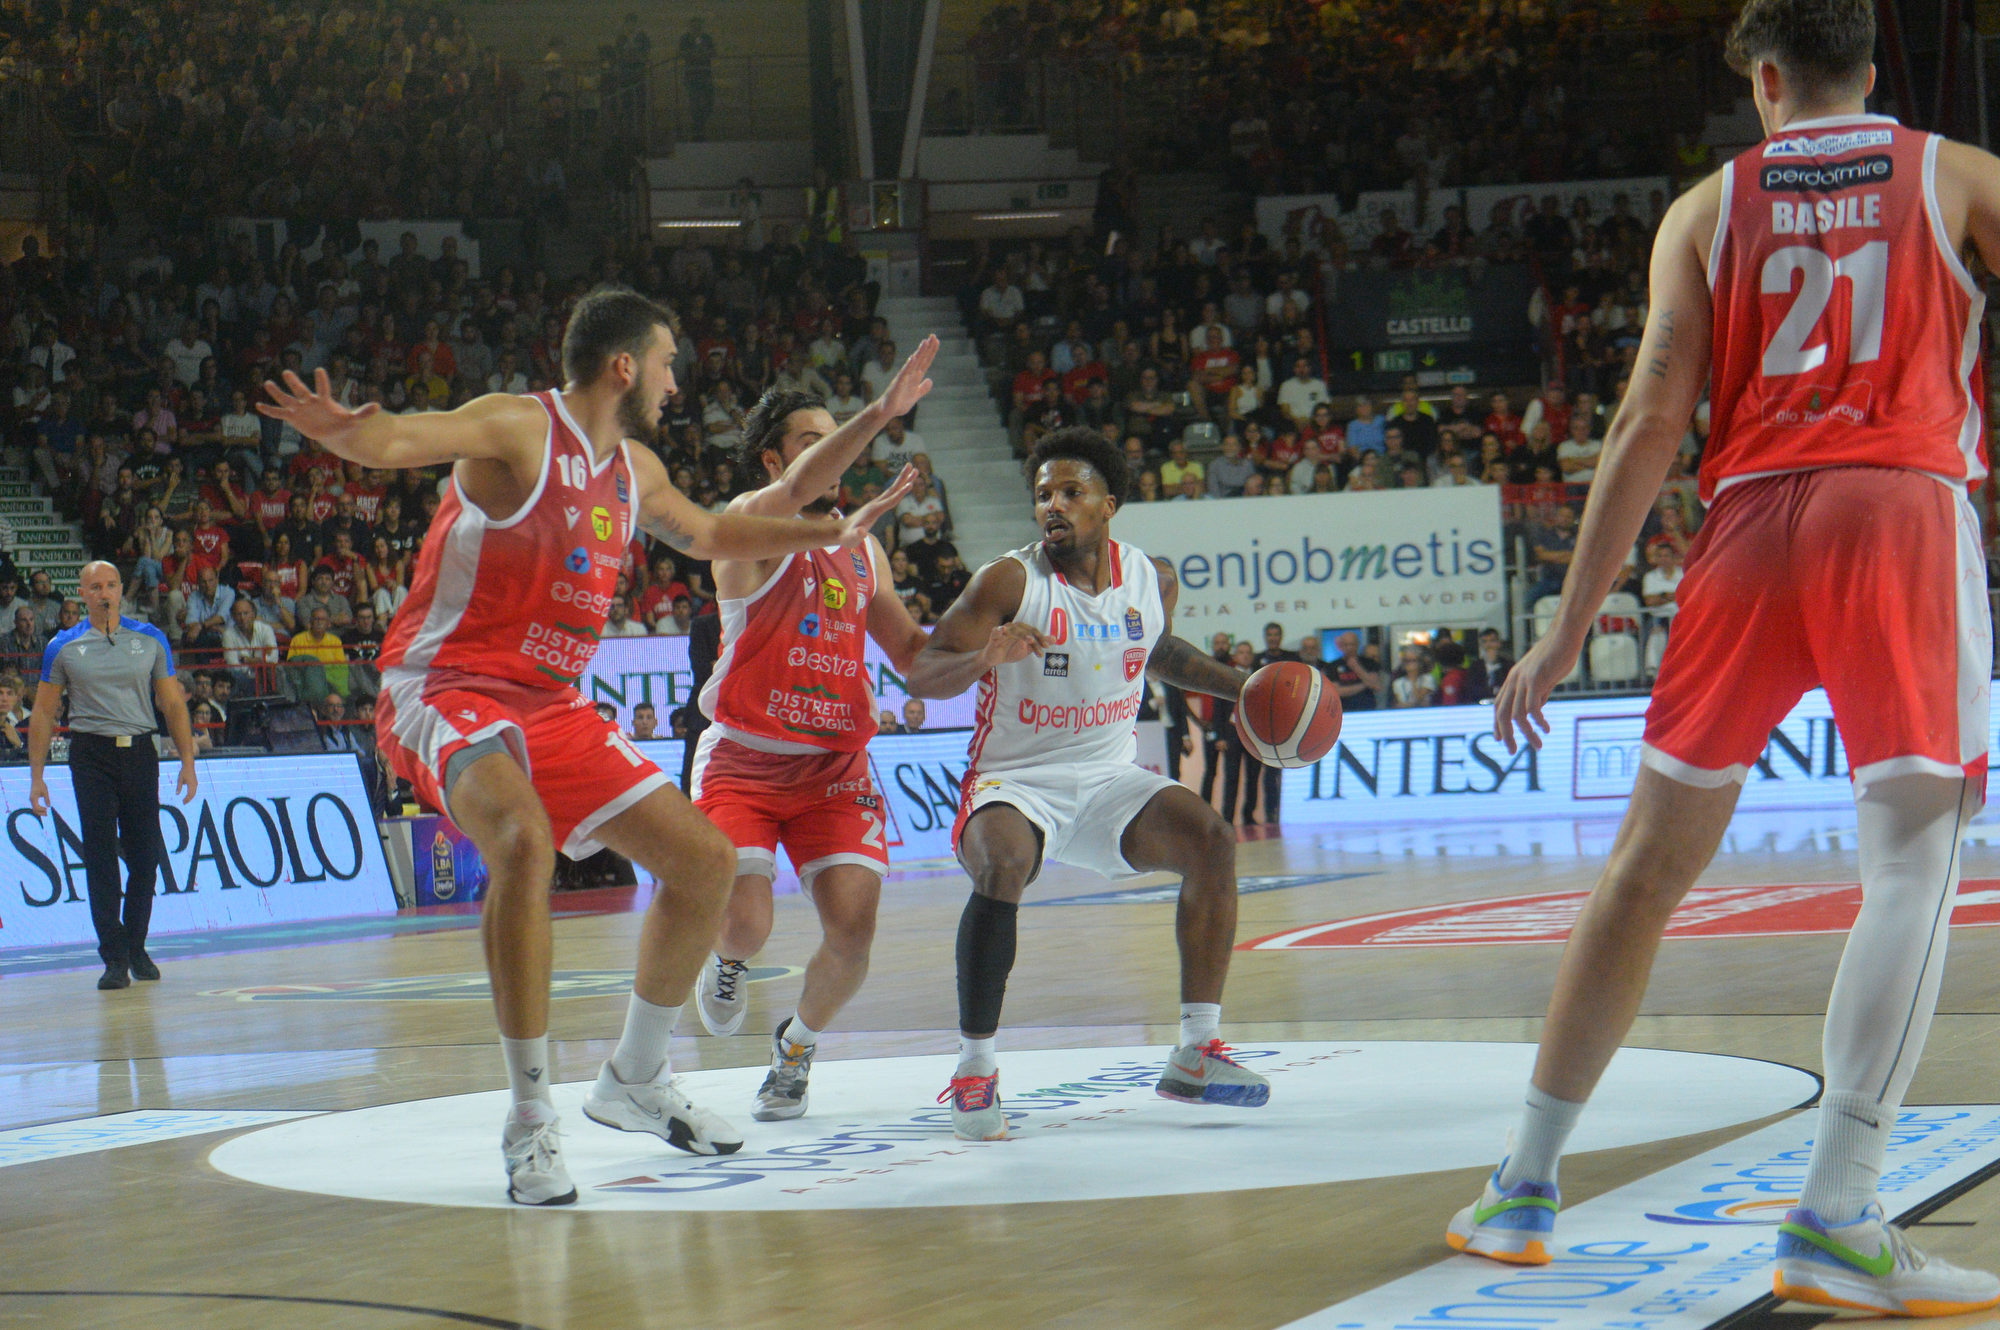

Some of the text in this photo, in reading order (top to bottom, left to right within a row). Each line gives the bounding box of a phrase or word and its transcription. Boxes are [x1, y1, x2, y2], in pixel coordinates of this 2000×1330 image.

[1765, 161, 1889, 188] perdormire
[1772, 195, 1880, 235] BASILE
[1760, 241, 1889, 377] 21
[1386, 316, 1473, 335] CASTELLO
[556, 454, 587, 491] 16
[1154, 529, 1496, 599] enjobmetis
[1254, 600, 1309, 614] PER
[1332, 597, 1357, 610] IL
[1380, 590, 1498, 608] LAVORO
[807, 651, 858, 678] estra
[766, 703, 856, 731] ECOLOGICI
[769, 689, 851, 717] DISTRETTI
[1304, 732, 1546, 800] INTESA
[6, 791, 364, 907] SAPAOLO
